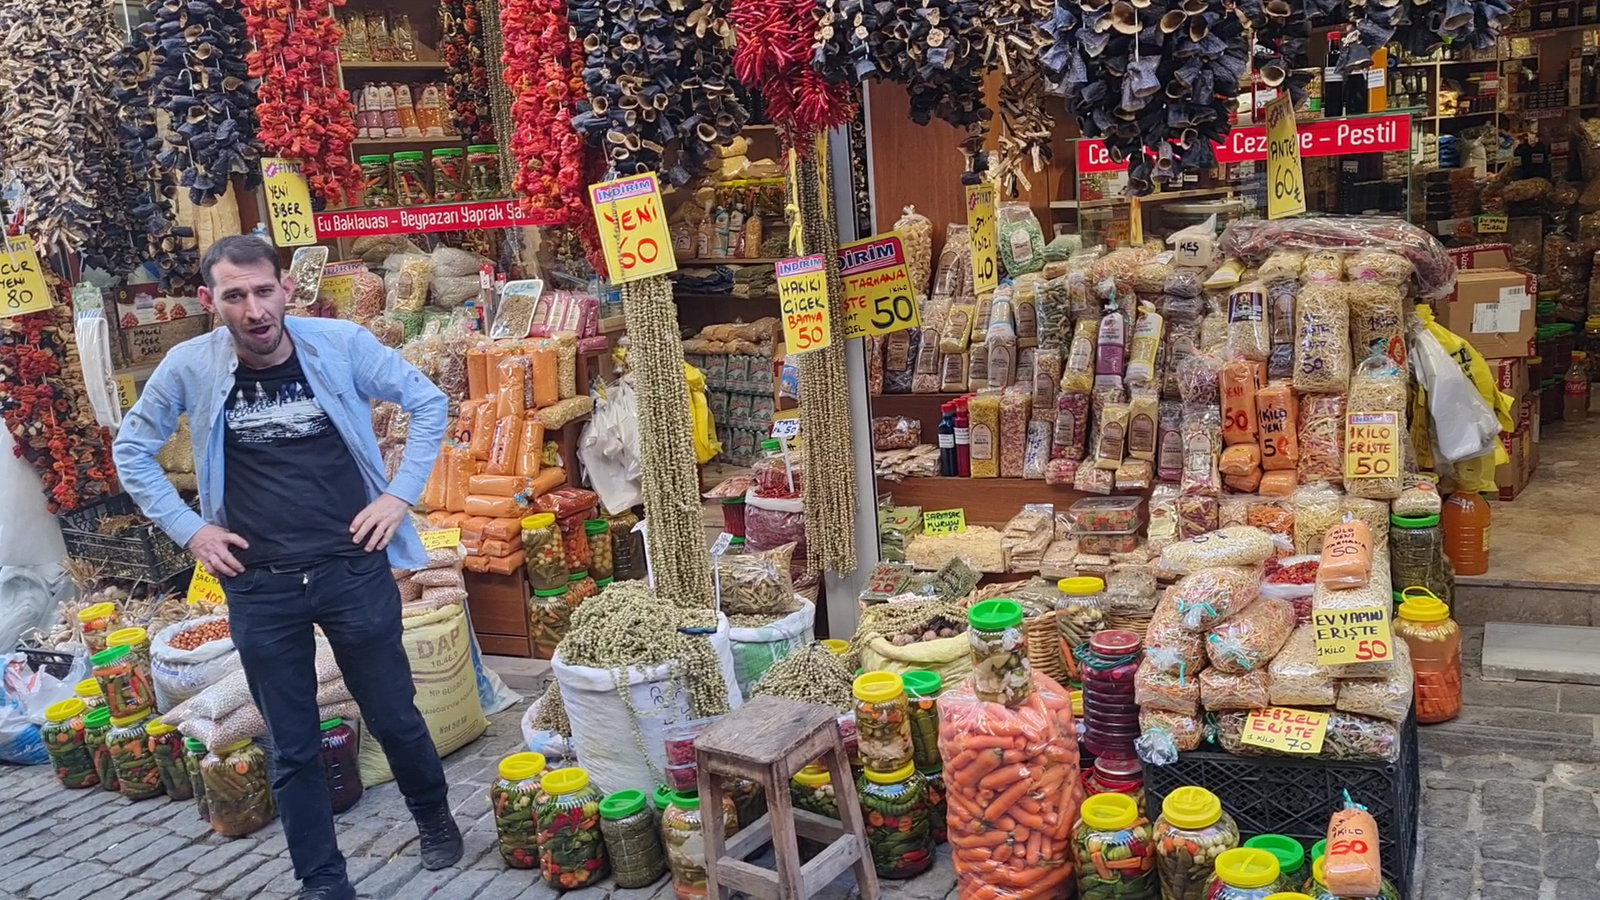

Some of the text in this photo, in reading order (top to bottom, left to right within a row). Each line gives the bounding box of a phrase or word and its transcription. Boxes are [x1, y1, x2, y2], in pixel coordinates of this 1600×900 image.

[1337, 120, 1396, 146] Pestil
[268, 181, 288, 199] YENİ
[598, 181, 650, 200] İNDİRİM
[1274, 164, 1294, 199] 60
[461, 205, 503, 226] Yaprak
[603, 197, 657, 231] YENİ
[281, 220, 300, 241] 80
[849, 269, 906, 291] TARHANA
[978, 257, 993, 284] 40
[8, 289, 33, 308] 80
[782, 298, 825, 315] ÇİÇEK
[843, 295, 868, 313] ŞTE
[871, 295, 914, 330] 50
[796, 326, 824, 350] 50
[1224, 407, 1249, 431] 50
[1348, 441, 1391, 456] ERİŞTE
[1354, 457, 1390, 475] 50
[1331, 546, 1358, 558] 50
[1316, 614, 1336, 626] EV
[416, 625, 460, 660] DAP
[1317, 626, 1379, 640] ERİŞTE
[1355, 640, 1387, 660] 50
[1251, 706, 1321, 726] SEBZELİ
[1285, 738, 1312, 750] 70
[1331, 840, 1368, 855] 50
